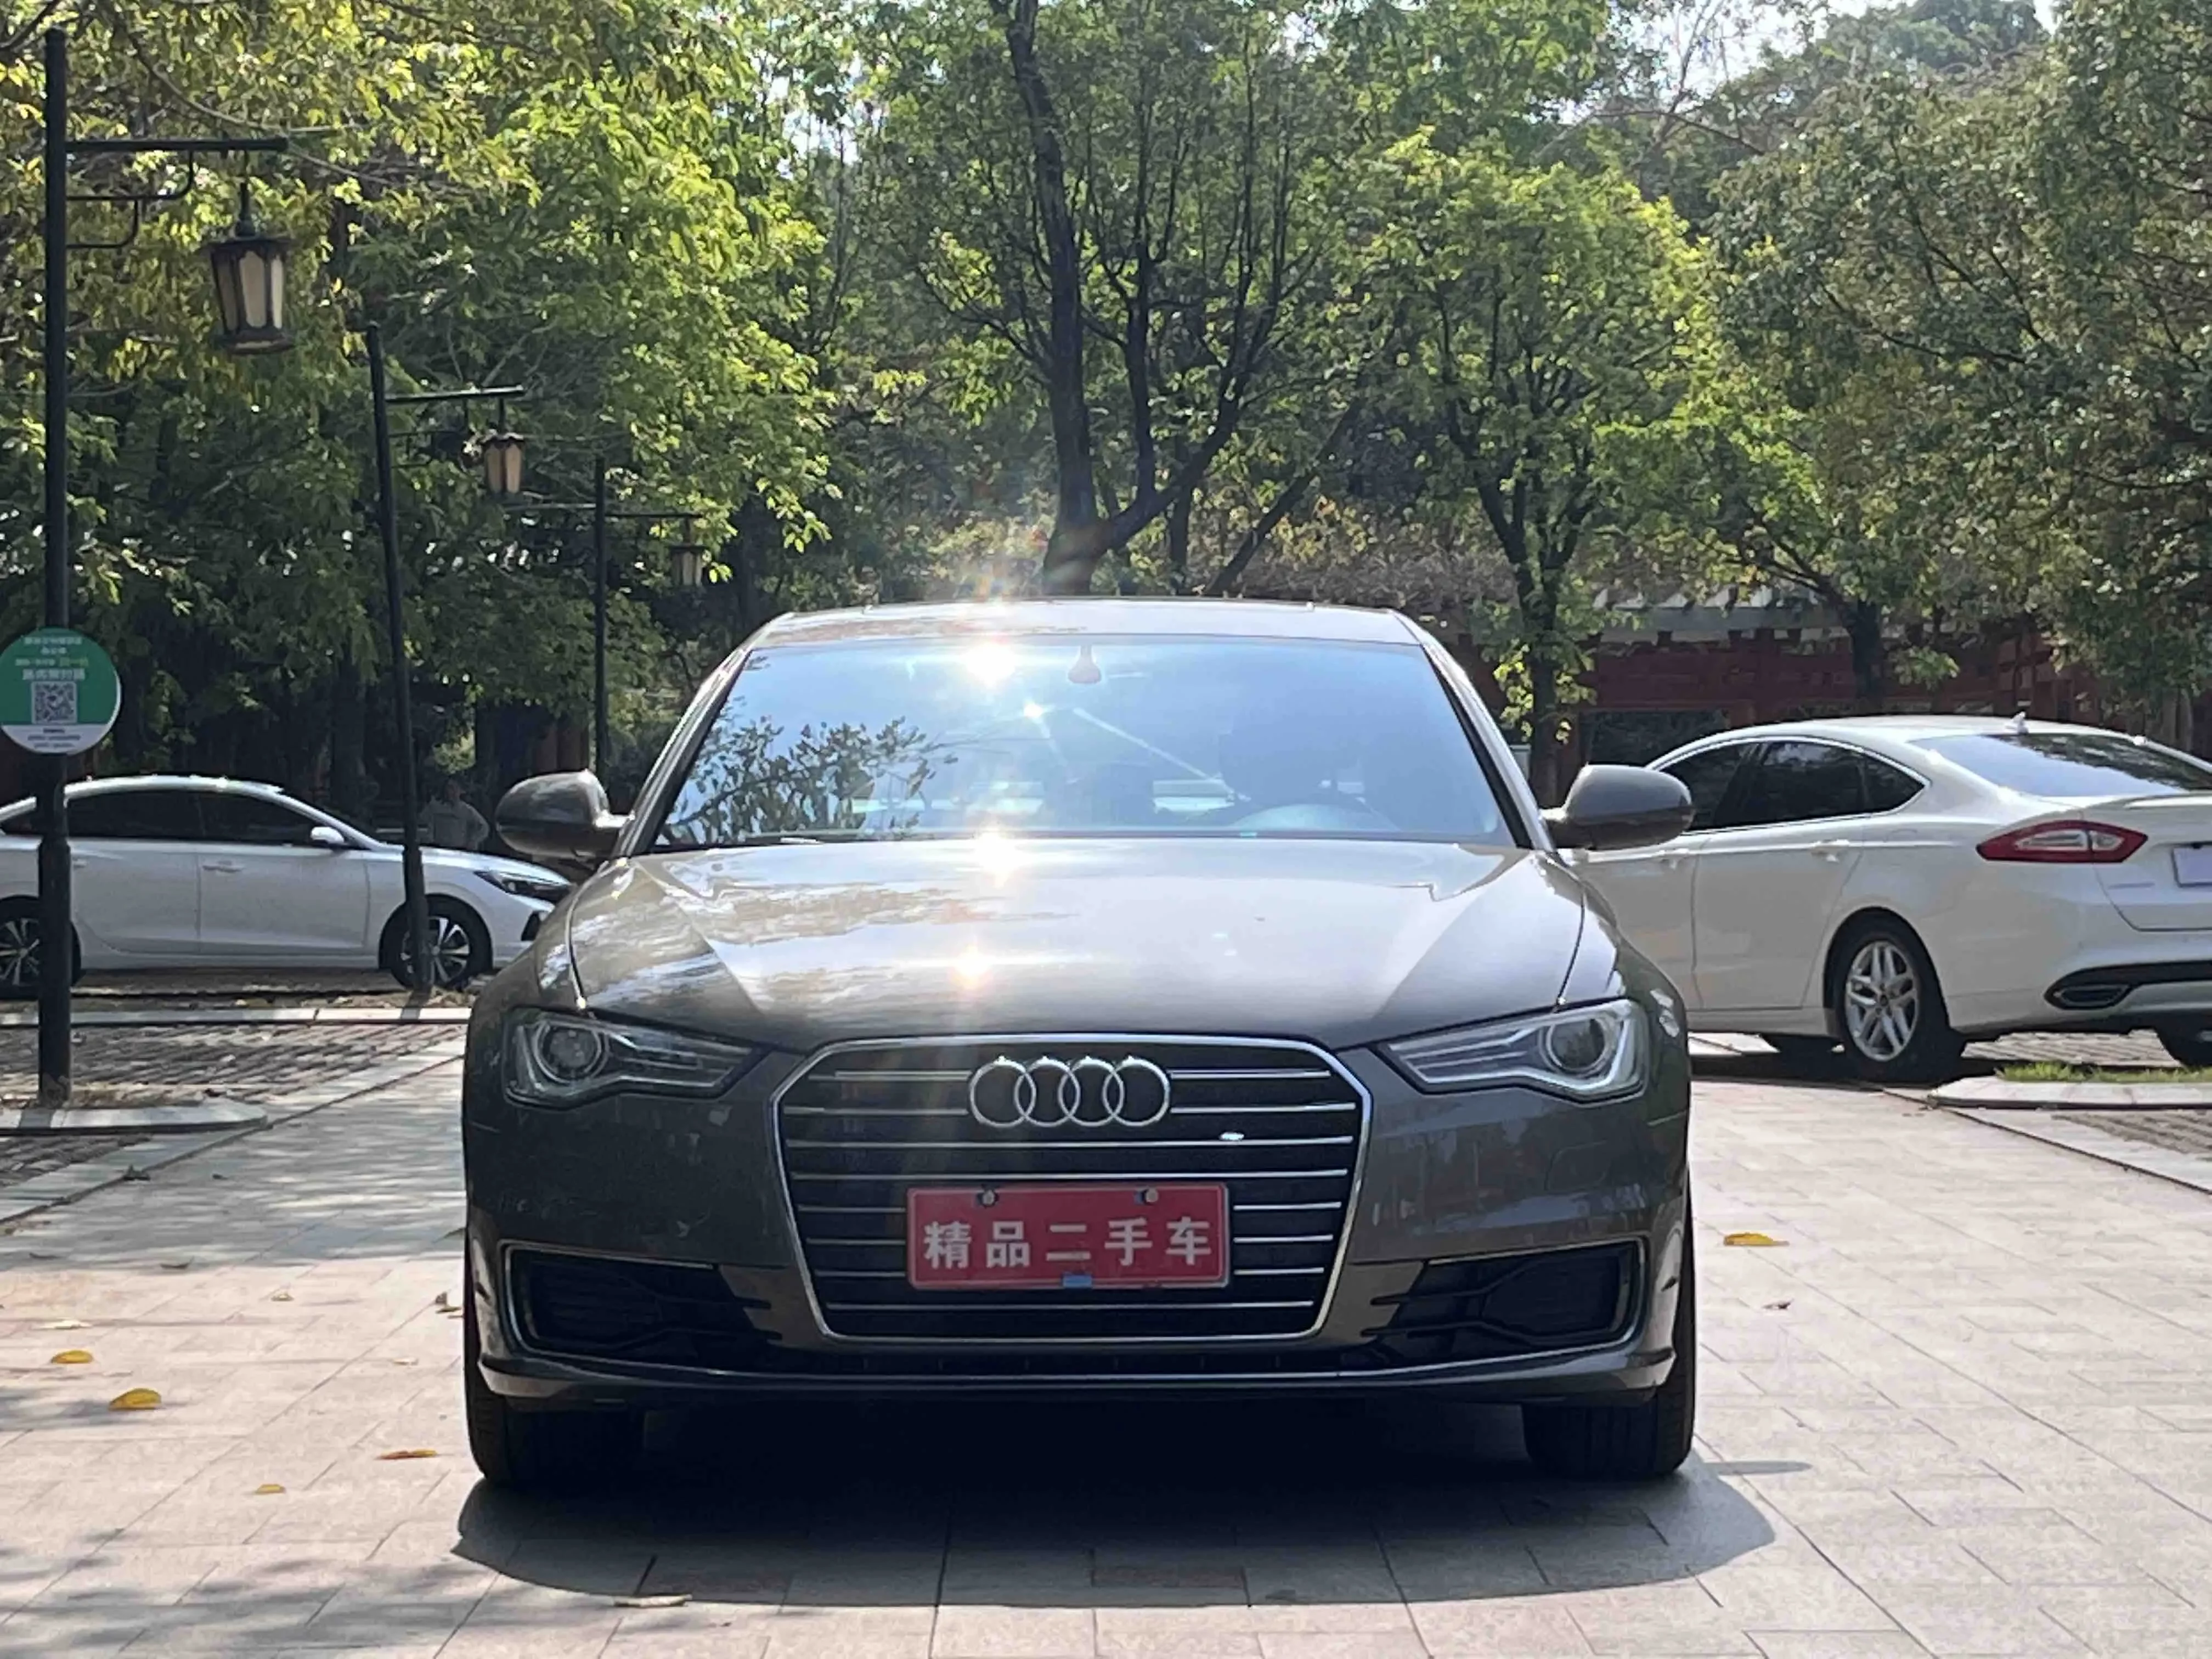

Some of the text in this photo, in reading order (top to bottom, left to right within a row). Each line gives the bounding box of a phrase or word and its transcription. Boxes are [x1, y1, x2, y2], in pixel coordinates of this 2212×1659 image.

[923, 1216, 1212, 1269] 精品二手车
